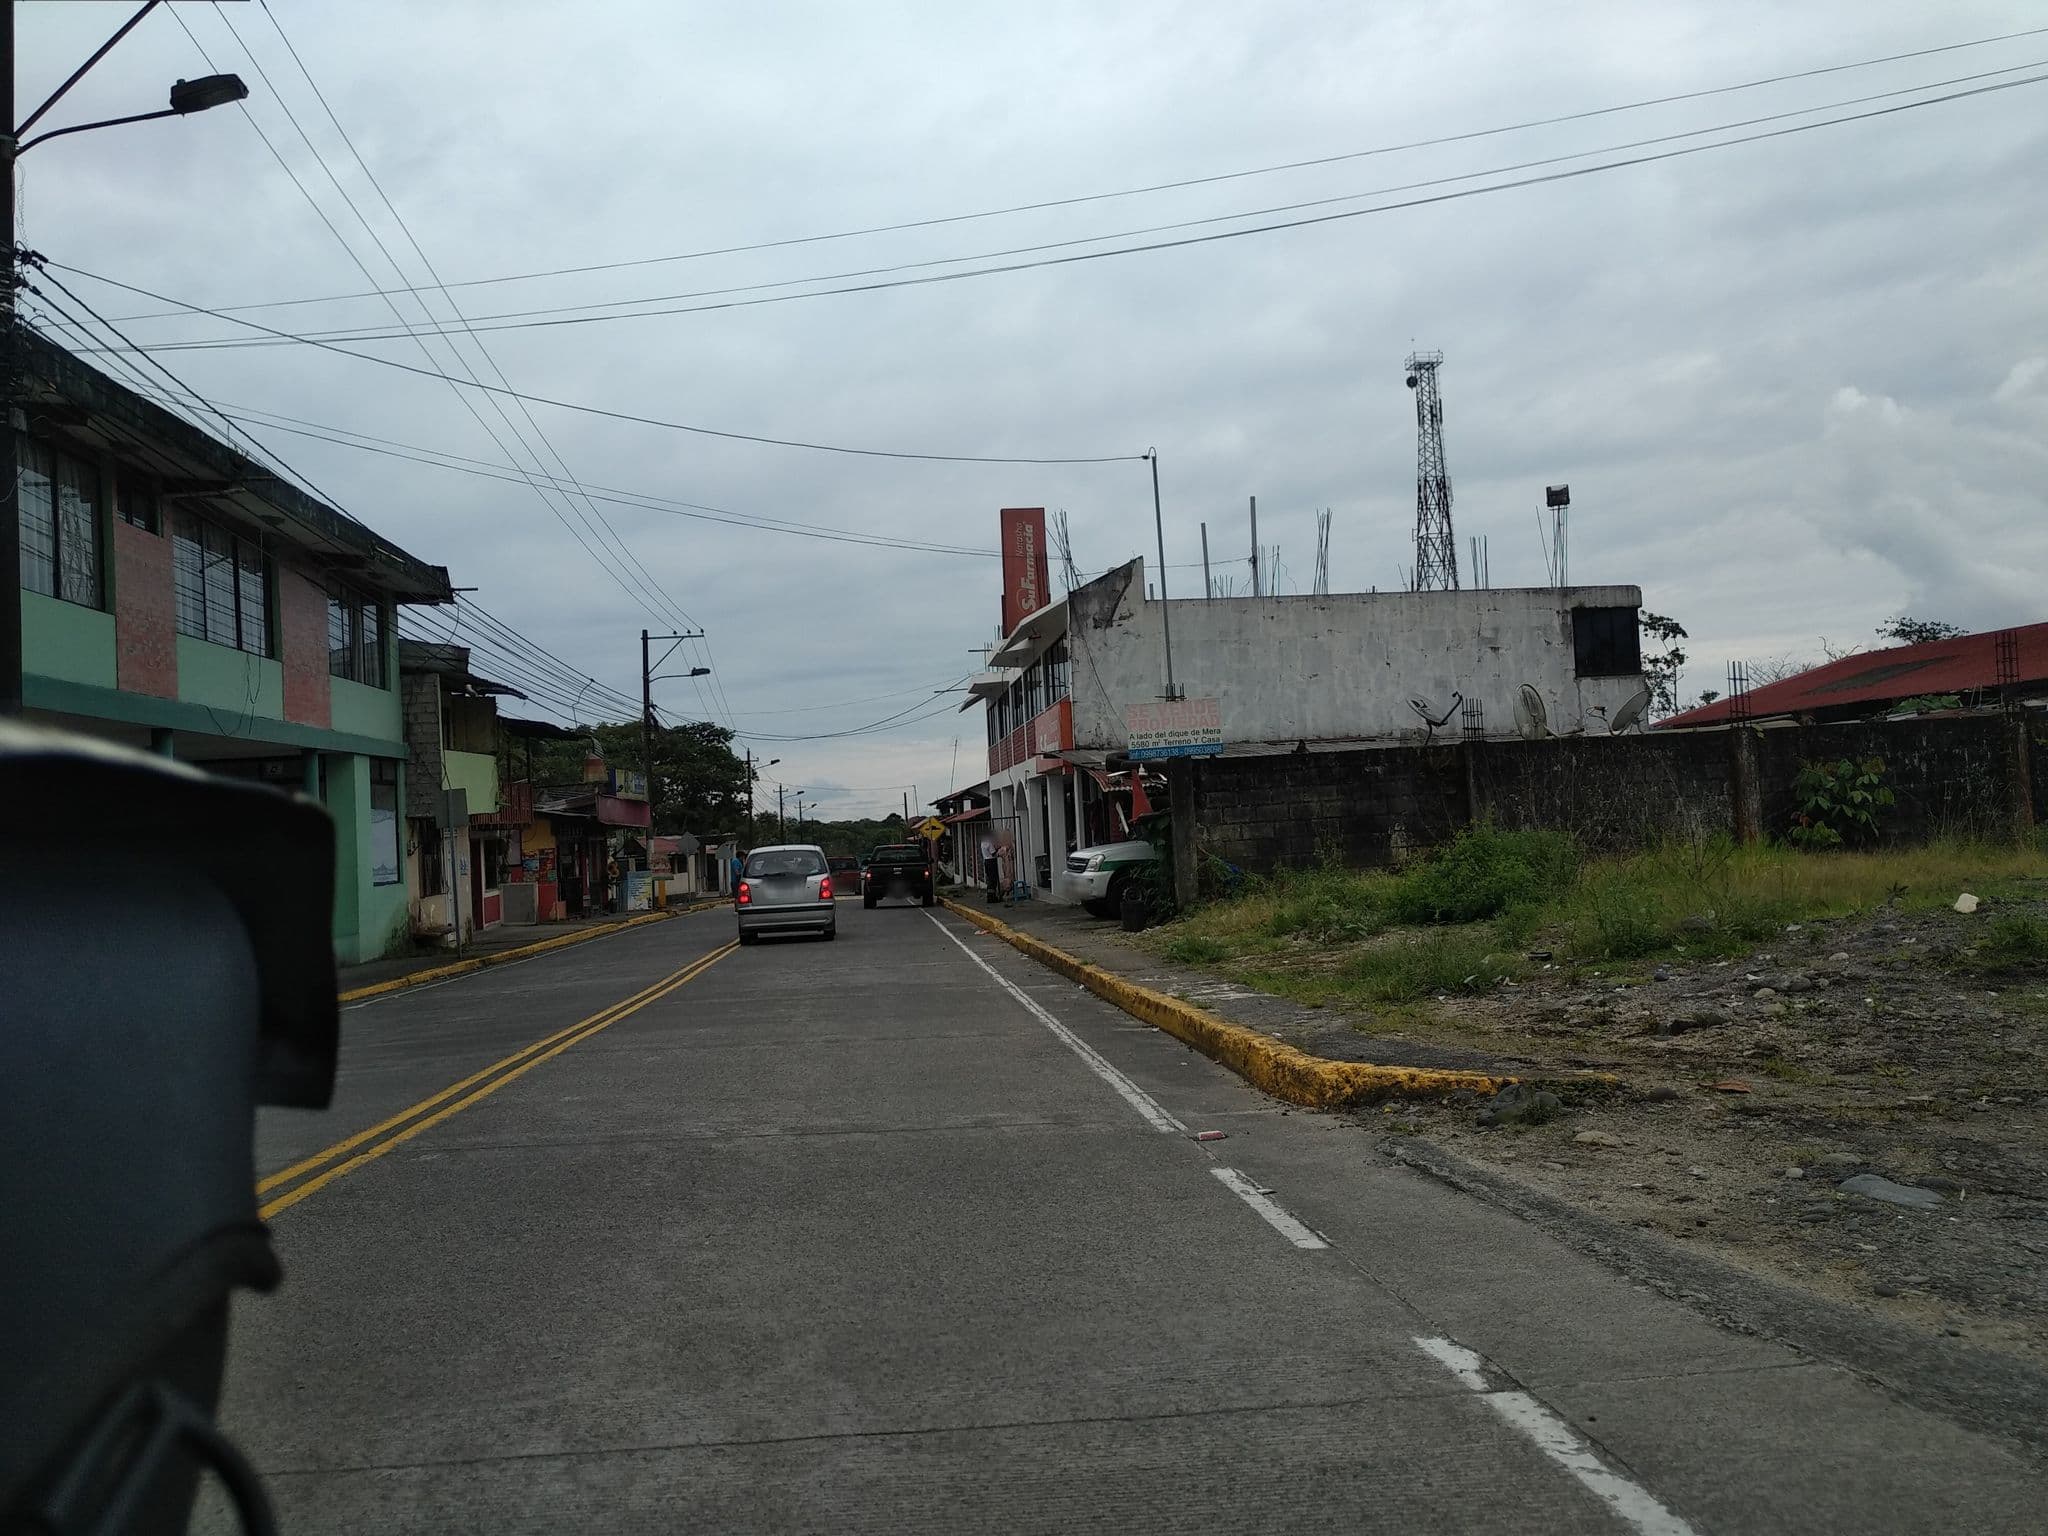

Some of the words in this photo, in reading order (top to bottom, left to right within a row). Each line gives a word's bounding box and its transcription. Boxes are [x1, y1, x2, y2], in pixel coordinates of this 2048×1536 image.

[1128, 704, 1151, 718] SE
[1158, 699, 1218, 716] VENDE
[1127, 715, 1221, 731] PROPIEDAD
[1136, 731, 1153, 740] lado
[1154, 731, 1166, 739] del
[1168, 729, 1189, 739] dique
[1190, 728, 1200, 736] de
[1202, 727, 1221, 736] Mera
[1131, 740, 1150, 749] 5580
[1163, 737, 1192, 747] Terreno
[1201, 735, 1221, 744] Casa
